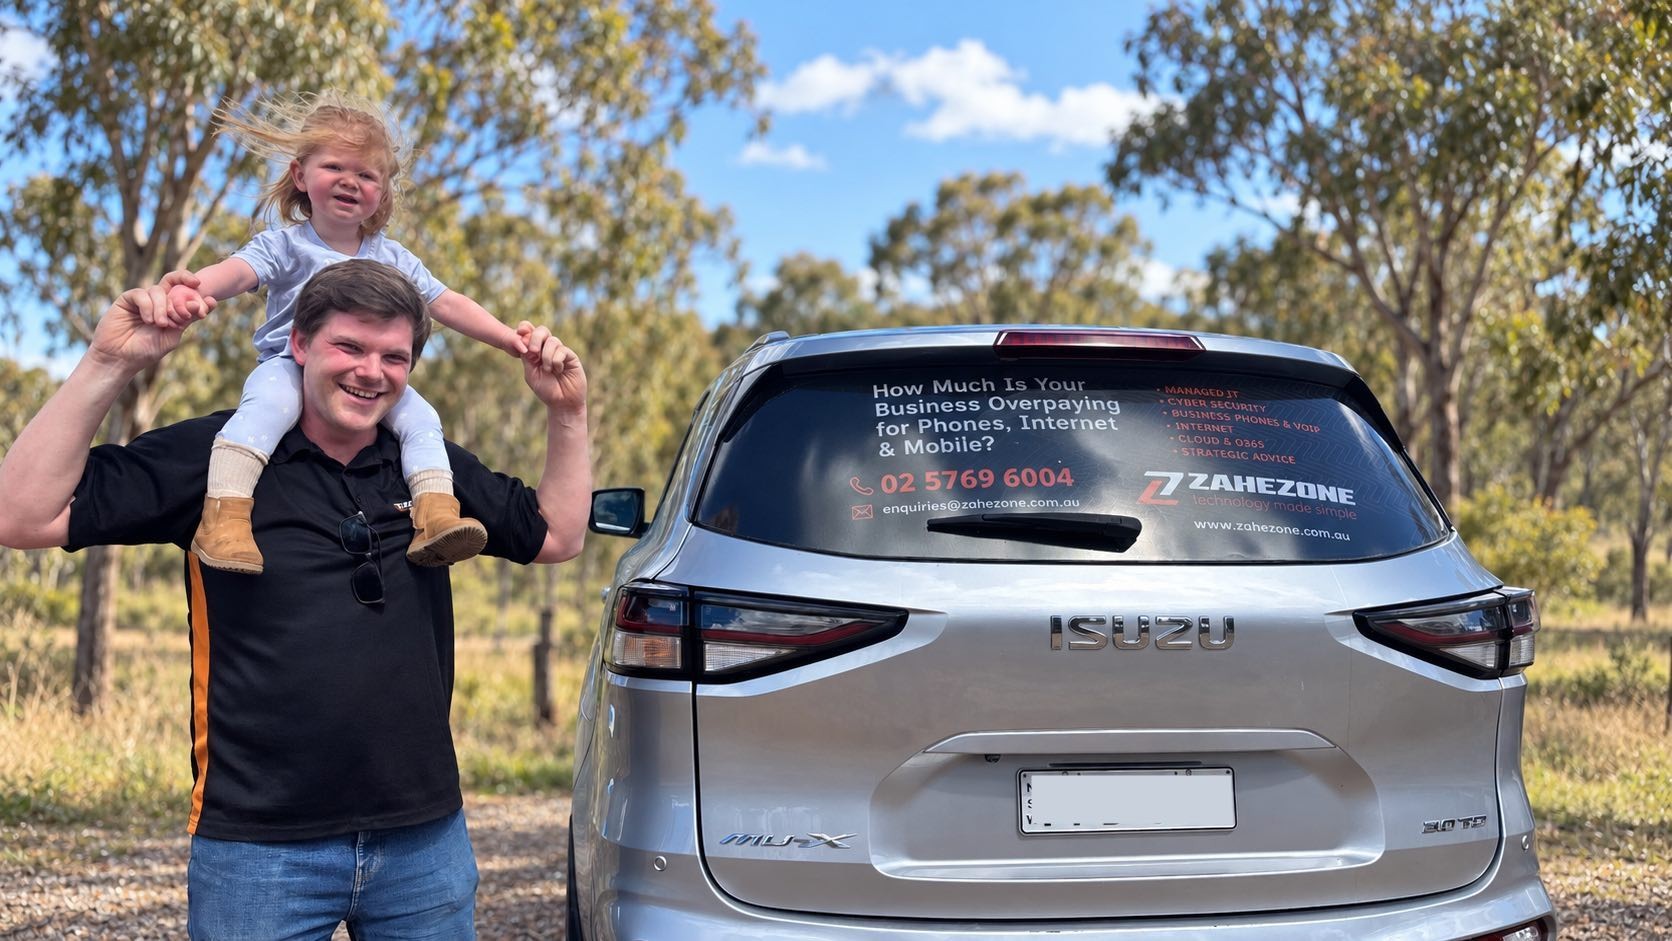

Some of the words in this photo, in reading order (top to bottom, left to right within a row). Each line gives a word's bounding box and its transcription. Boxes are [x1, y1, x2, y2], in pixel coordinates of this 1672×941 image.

[873, 383, 923, 398] How
[933, 378, 995, 394] Much
[1004, 377, 1028, 392] Is
[1034, 378, 1086, 392] Your
[1165, 386, 1224, 397] MANAGED
[1226, 390, 1240, 398] IT
[875, 398, 981, 417] Business
[988, 396, 1121, 414] Overpaying
[1168, 398, 1206, 407] CYBER
[1210, 401, 1266, 412] SECURITY
[876, 421, 910, 437] for
[918, 418, 1011, 434] Phones,
[1019, 415, 1118, 431] Internet
[1172, 409, 1230, 420] BUSINESS
[1234, 414, 1280, 426] PHONES
[1282, 420, 1292, 428] &
[1293, 422, 1320, 432] VOIP
[1176, 422, 1234, 433] INTERNET
[879, 442, 895, 457] &
[904, 436, 995, 456] Mobile?
[1178, 434, 1220, 444] CLOUD
[1224, 437, 1232, 446] &
[1182, 447, 1248, 460] STRATEGIC
[1253, 452, 1296, 464] ADVICE
[880, 472, 916, 494] 02
[924, 468, 994, 491] 5769
[1004, 467, 1074, 488] 6004
[1188, 472, 1356, 506] ZAHEZONE
[882, 498, 1080, 516] enquiries@zahezone.com.au
[1273, 502, 1312, 514] made
[1315, 506, 1358, 520] simple
[1194, 519, 1350, 542] www.zahezone.com.au
[1050, 614, 1235, 650] ISUZU
